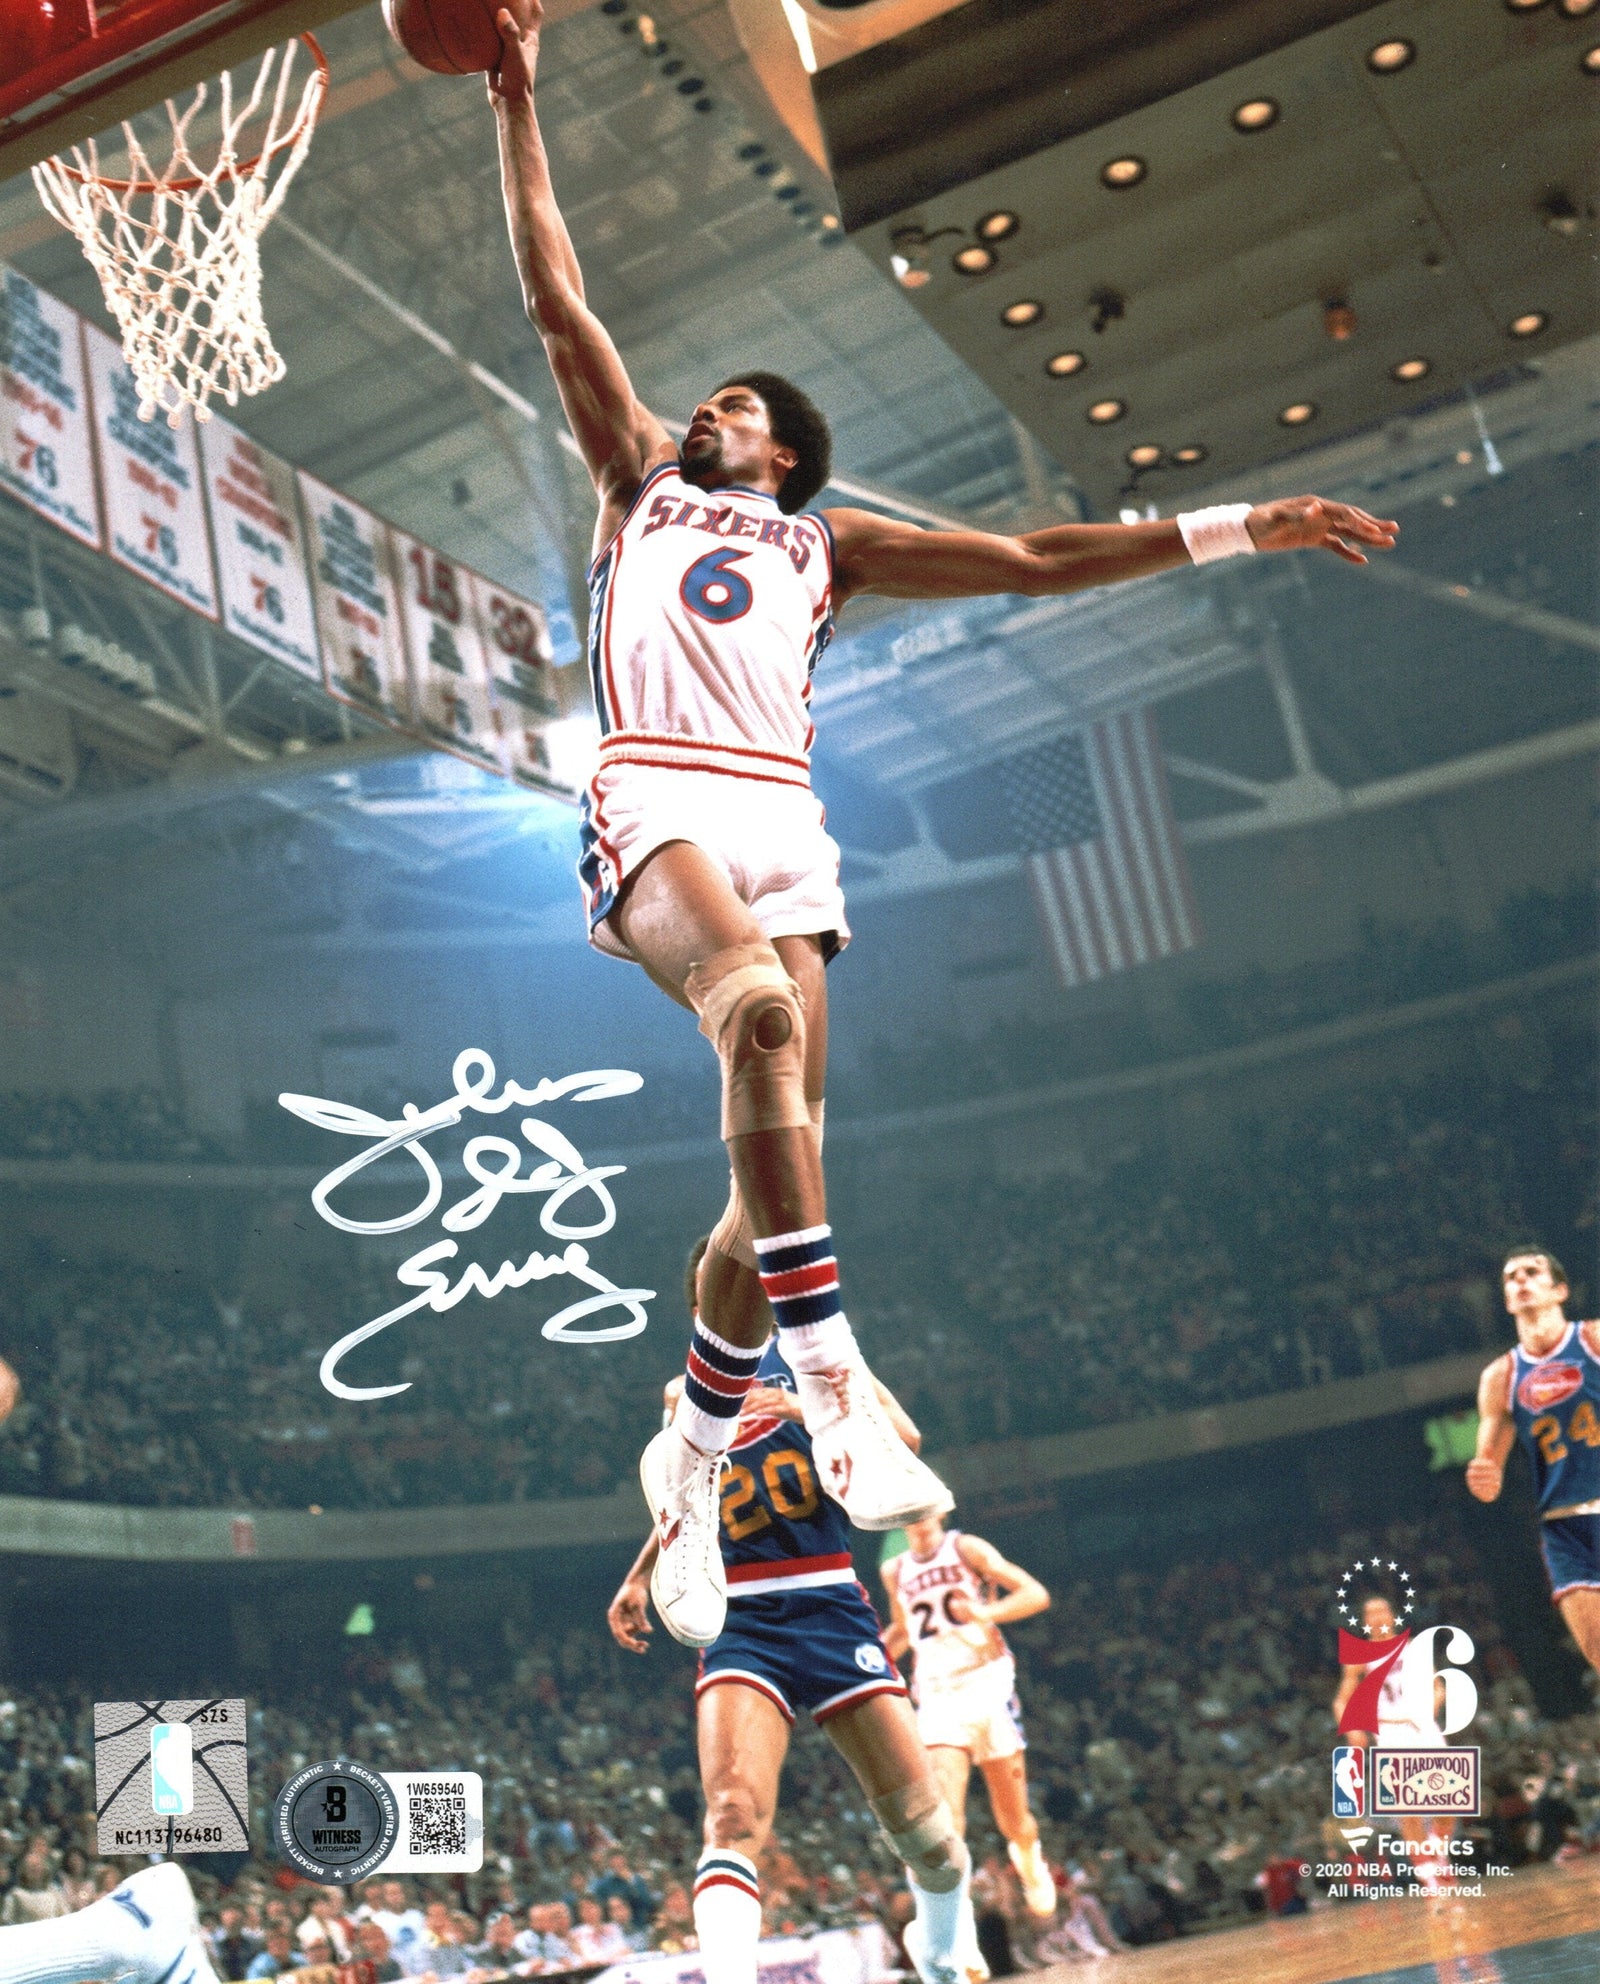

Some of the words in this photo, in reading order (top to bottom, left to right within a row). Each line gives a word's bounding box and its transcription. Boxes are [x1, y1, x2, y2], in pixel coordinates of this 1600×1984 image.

[640, 495, 817, 574] SIXERS
[679, 546, 754, 624] 6
[1530, 1402, 1600, 1465] 24
[719, 1447, 819, 1542] 20
[284, 1765, 324, 1804] AUTHENTIC
[350, 1765, 386, 1795] BECKETT
[406, 1783, 464, 1795] 1W659540
[279, 1804, 293, 1847] VERIFIED
[380, 1793, 395, 1836] VERIFIED
[115, 1827, 222, 1845] NC113796480
[312, 1830, 361, 1845] WITNESS
[289, 1846, 324, 1876] BECKETT
[351, 1837, 390, 1876] AUTHENTIC
